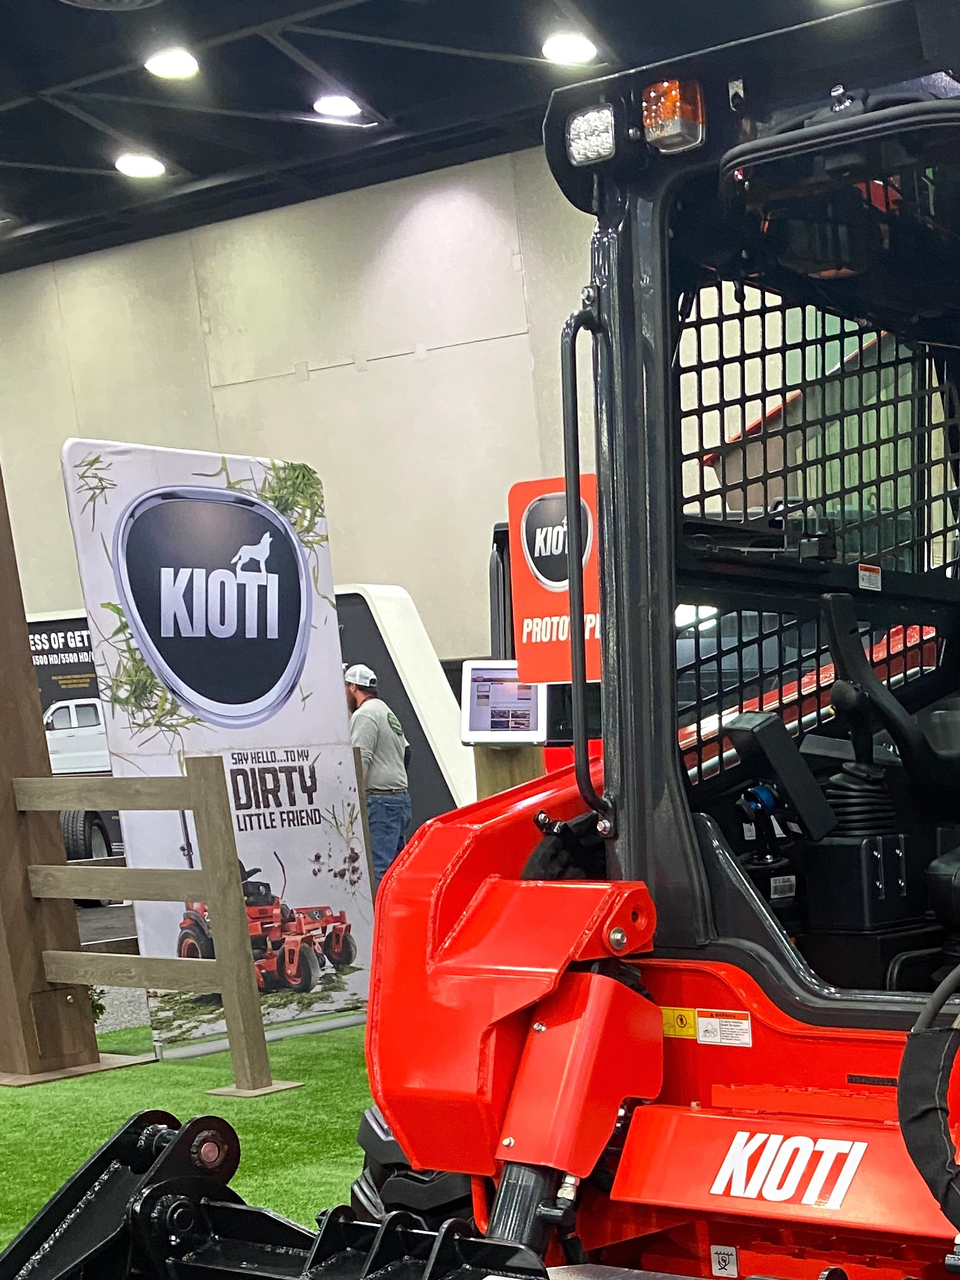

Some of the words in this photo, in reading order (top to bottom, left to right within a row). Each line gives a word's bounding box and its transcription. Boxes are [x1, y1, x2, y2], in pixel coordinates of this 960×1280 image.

[534, 525, 568, 557] KIO
[160, 567, 279, 640] KIOTI
[50, 631, 65, 650] OF
[66, 629, 91, 649] GET
[522, 612, 601, 644] PROTOP
[231, 752, 249, 765] SAY
[296, 749, 309, 762] MY
[229, 765, 318, 811] DIRTY
[236, 812, 277, 832] LITTLE
[279, 808, 322, 828] FRIEND
[709, 1130, 869, 1210] KIOTI
